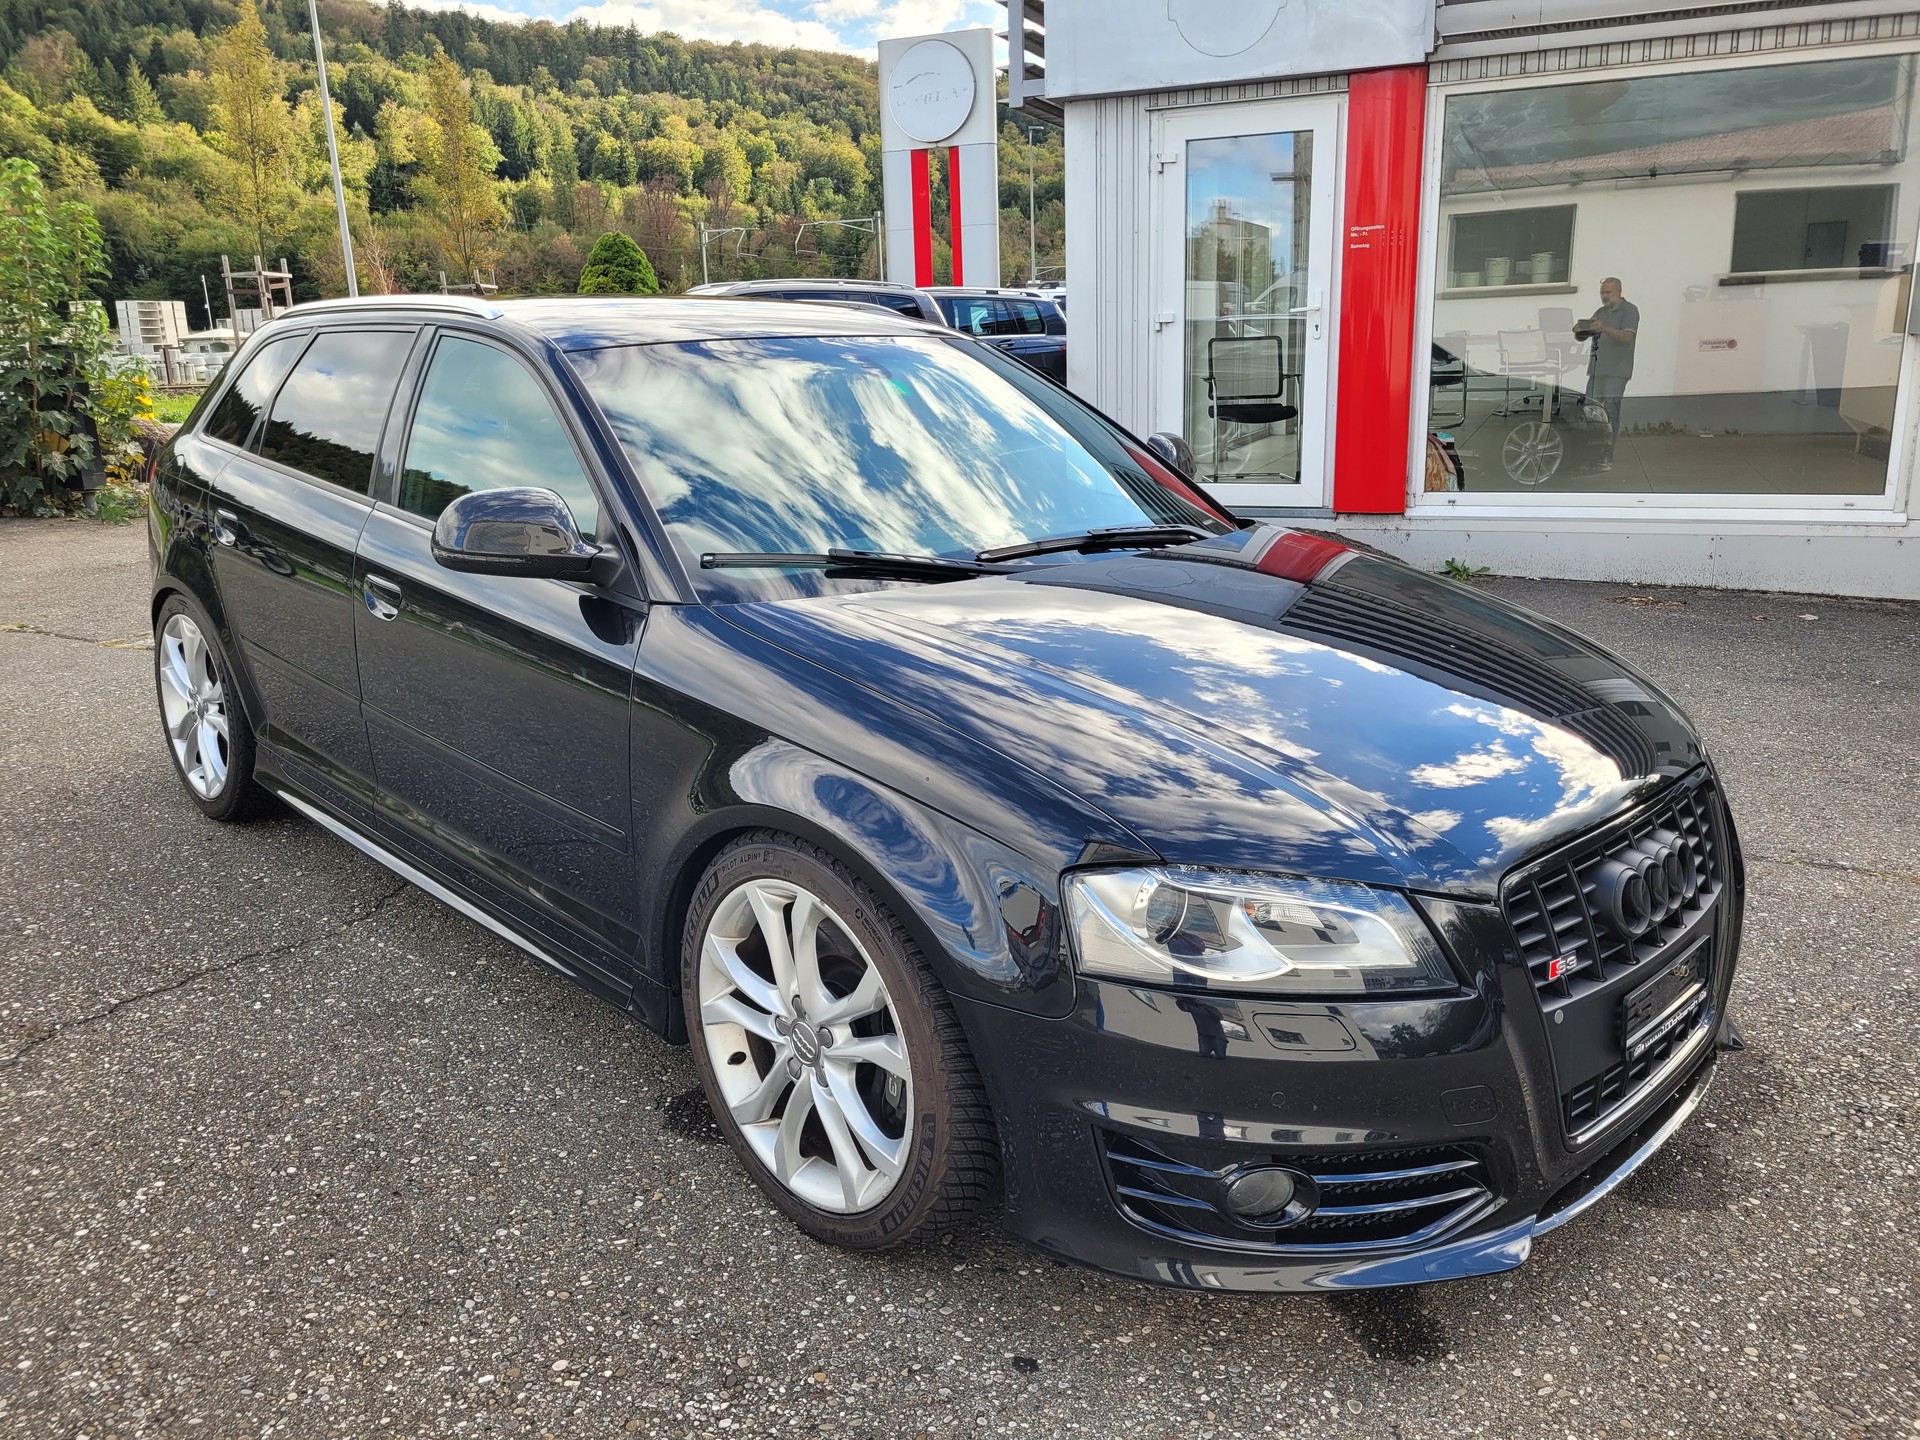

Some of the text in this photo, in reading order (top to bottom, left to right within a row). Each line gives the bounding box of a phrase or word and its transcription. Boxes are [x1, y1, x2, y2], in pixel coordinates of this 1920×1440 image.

[722, 858, 737, 874] PILOT
[684, 870, 720, 961] MICHELIN
[863, 917, 883, 943] MICHELIN
[1555, 955, 1578, 975] S3
[884, 1145, 933, 1233] MICHELIN
